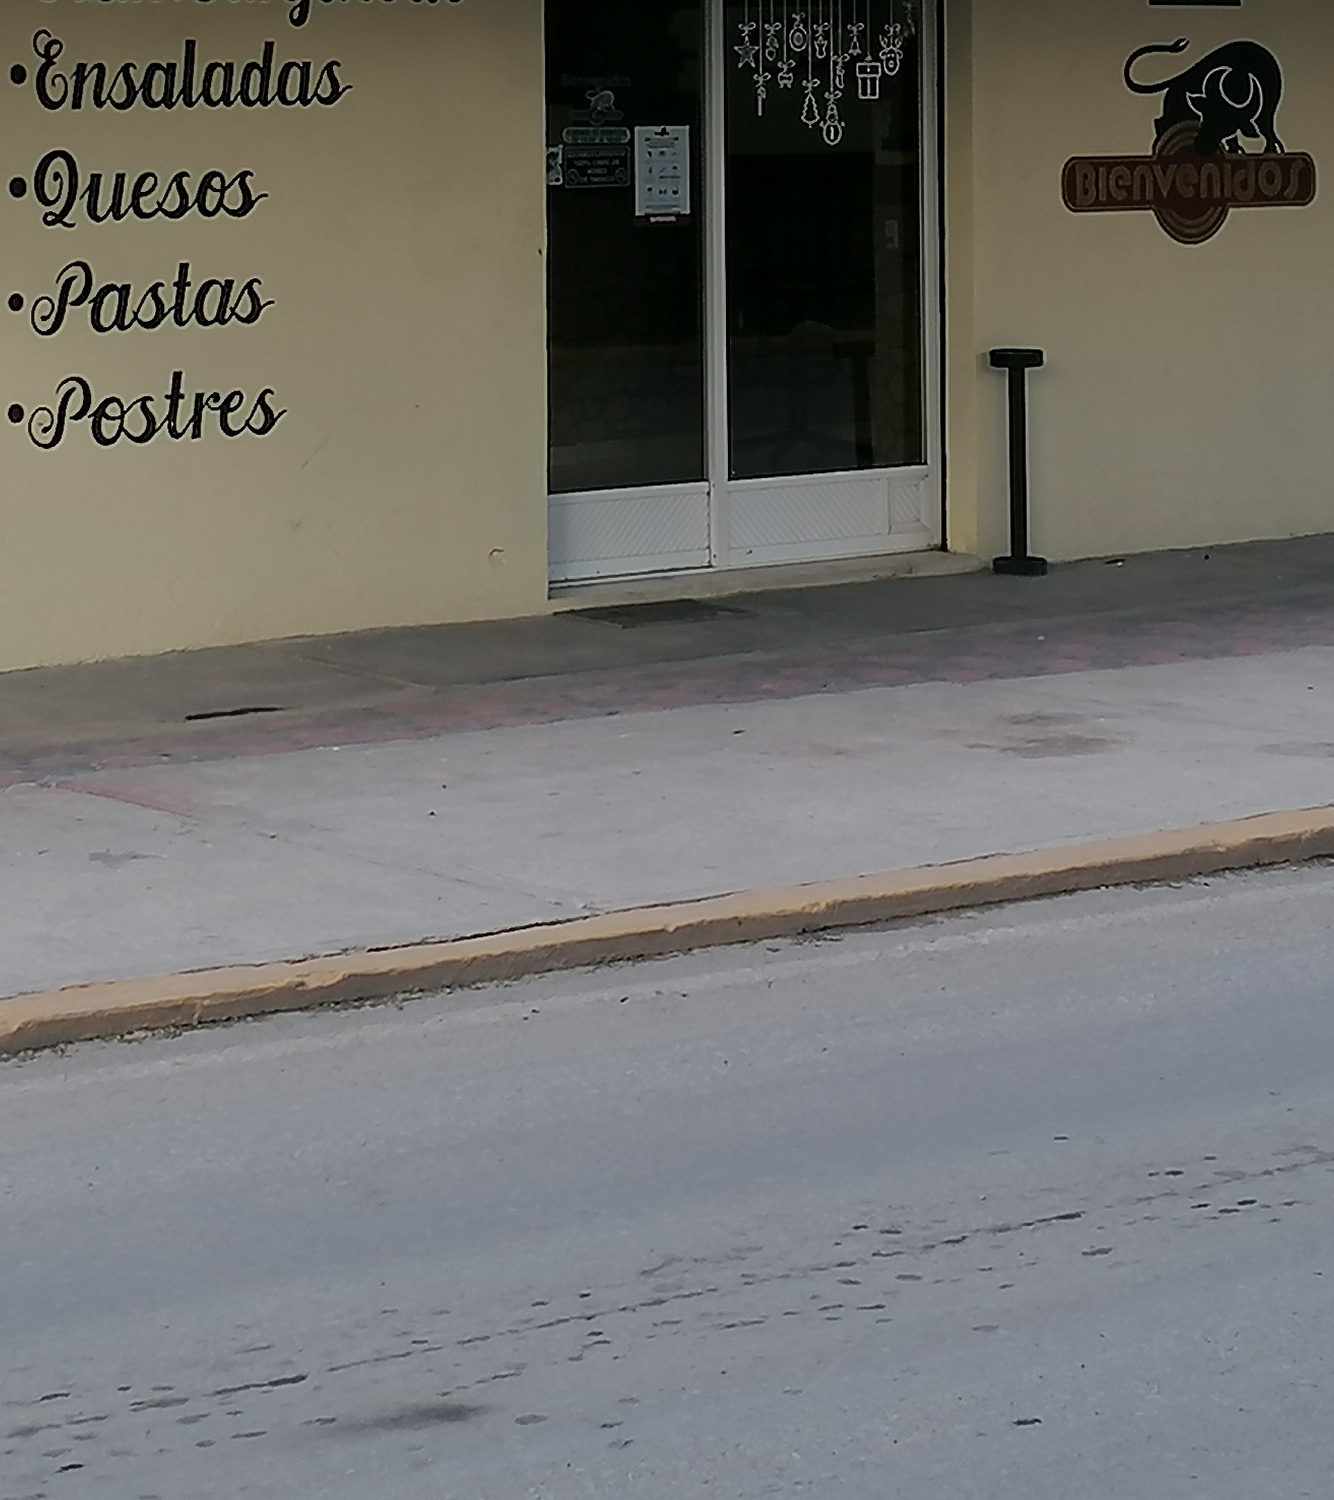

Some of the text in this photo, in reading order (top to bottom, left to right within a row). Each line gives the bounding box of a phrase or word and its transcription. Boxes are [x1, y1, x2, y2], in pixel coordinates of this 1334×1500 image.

[31, 29, 353, 110] Ensaladas
[33, 148, 269, 228] Quesos
[30, 260, 275, 336] Pastas
[28, 371, 287, 450] Postres
